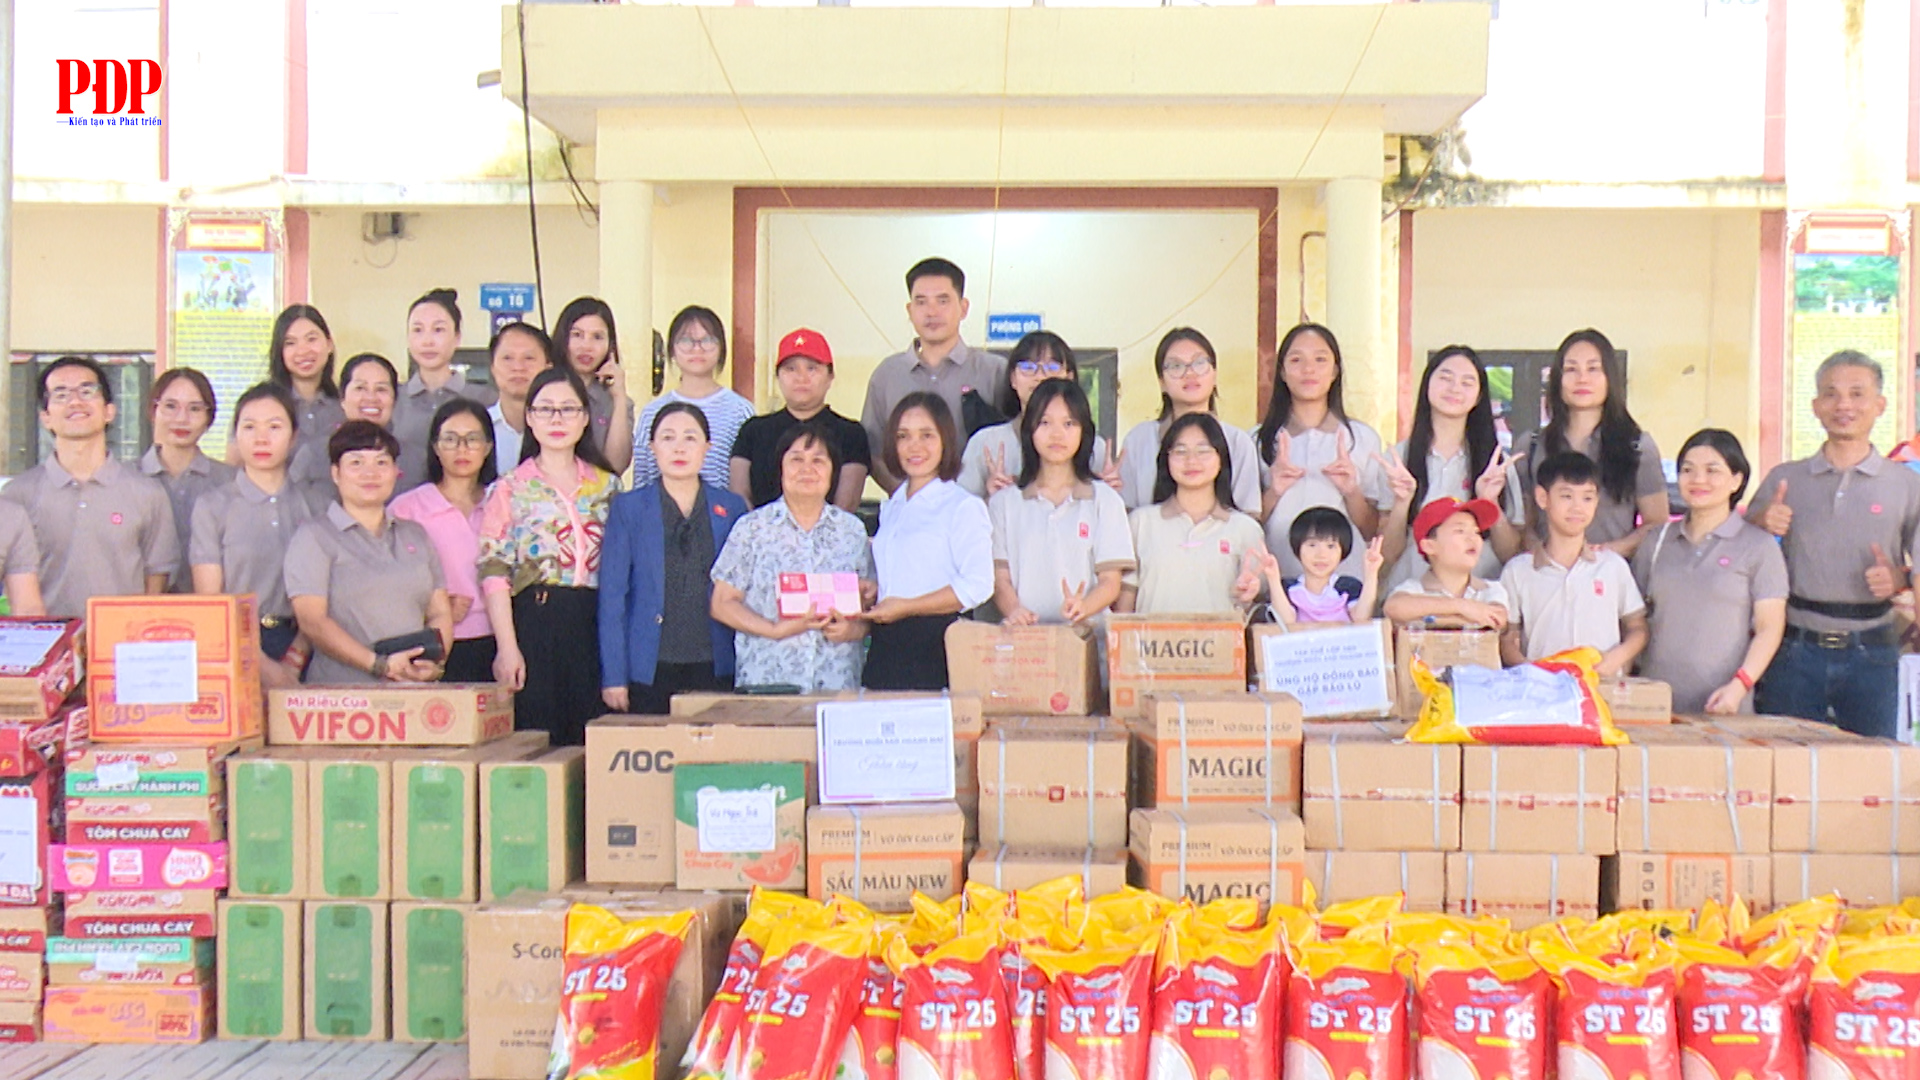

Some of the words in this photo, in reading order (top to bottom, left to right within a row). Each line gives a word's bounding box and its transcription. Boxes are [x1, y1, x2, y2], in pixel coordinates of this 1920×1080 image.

[1140, 639, 1215, 658] MAGIC
[307, 697, 338, 708] Riêu
[342, 697, 368, 707] Cua
[288, 711, 406, 741] VIFON
[1168, 717, 1215, 726] PRMIUM
[608, 749, 675, 774] AOC
[1188, 758, 1268, 778] MAGIC
[85, 825, 118, 839] TÔM
[119, 827, 159, 839] CHUA
[161, 827, 191, 839] CAY
[821, 829, 871, 838] PREMIM
[862, 870, 901, 890] MÀU
[905, 874, 948, 890] NEW
[84, 920, 117, 935] TÔM
[119, 922, 161, 934] CHUA
[163, 921, 194, 934] CAY
[564, 967, 592, 995] ST
[594, 965, 628, 991] 25
[717, 967, 738, 991] T
[770, 985, 810, 1018] 25
[920, 1002, 957, 1030] ST
[966, 1000, 997, 1028] 25
[1175, 999, 1214, 1026] ST
[1223, 1002, 1257, 1028] 25
[1060, 1004, 1095, 1033] ST
[1105, 1005, 1140, 1034] 25
[1310, 1001, 1348, 1028] ST
[1357, 1005, 1392, 1034] 25
[1454, 1004, 1496, 1033] ST
[1584, 1003, 1626, 1033] ST
[1692, 1003, 1731, 1033] ST
[1740, 1003, 1782, 1034] 25
[1835, 1012, 1879, 1043] ST
[1887, 1016, 1920, 1048] 25
